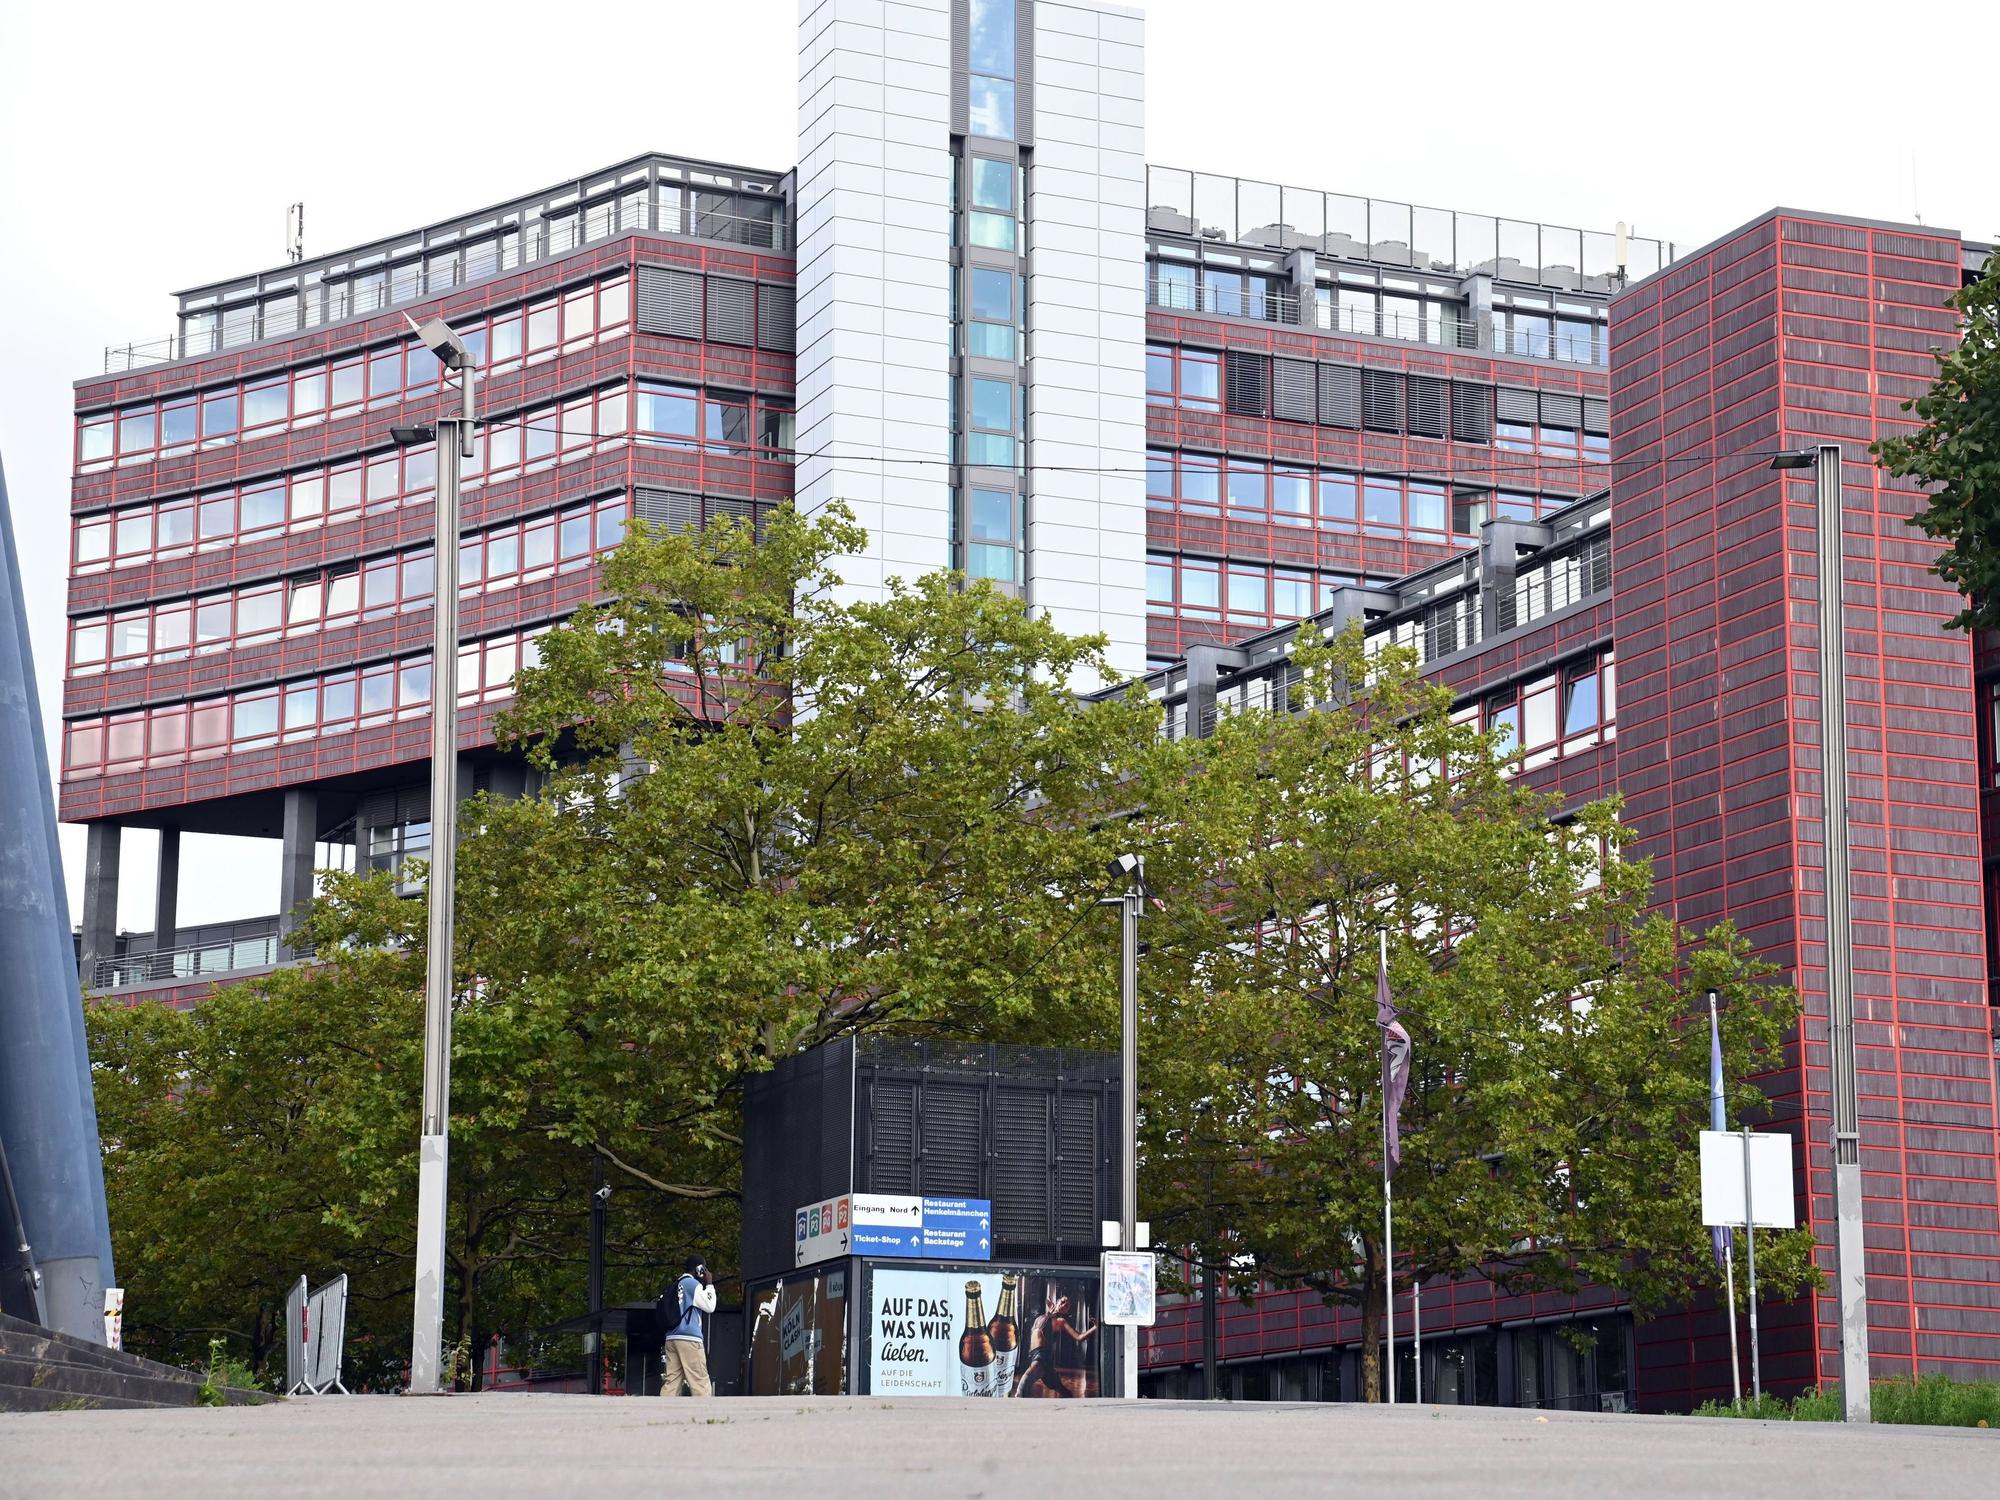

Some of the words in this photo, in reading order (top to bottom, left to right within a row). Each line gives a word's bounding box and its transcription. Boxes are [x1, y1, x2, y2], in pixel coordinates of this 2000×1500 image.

[924, 1199, 966, 1208] Restaurant
[854, 1204, 885, 1213] Eingang
[890, 1205, 908, 1213] Nord
[924, 1208, 989, 1217] Henkelmännchen
[798, 1221, 806, 1236] P1
[811, 1219, 819, 1233] P3
[839, 1210, 847, 1224] P2
[924, 1229, 966, 1238] Restaurant
[854, 1234, 901, 1244] Ticket-Shop
[924, 1238, 964, 1246] Backstage
[881, 1297, 914, 1316] AUF
[918, 1298, 953, 1321] DAS,
[881, 1320, 915, 1339] WAS
[920, 1321, 950, 1340] WIR
[881, 1341, 929, 1362] lieben.
[899, 1369, 913, 1377] DIE
[881, 1379, 942, 1388] LEIDENSCHAFT
